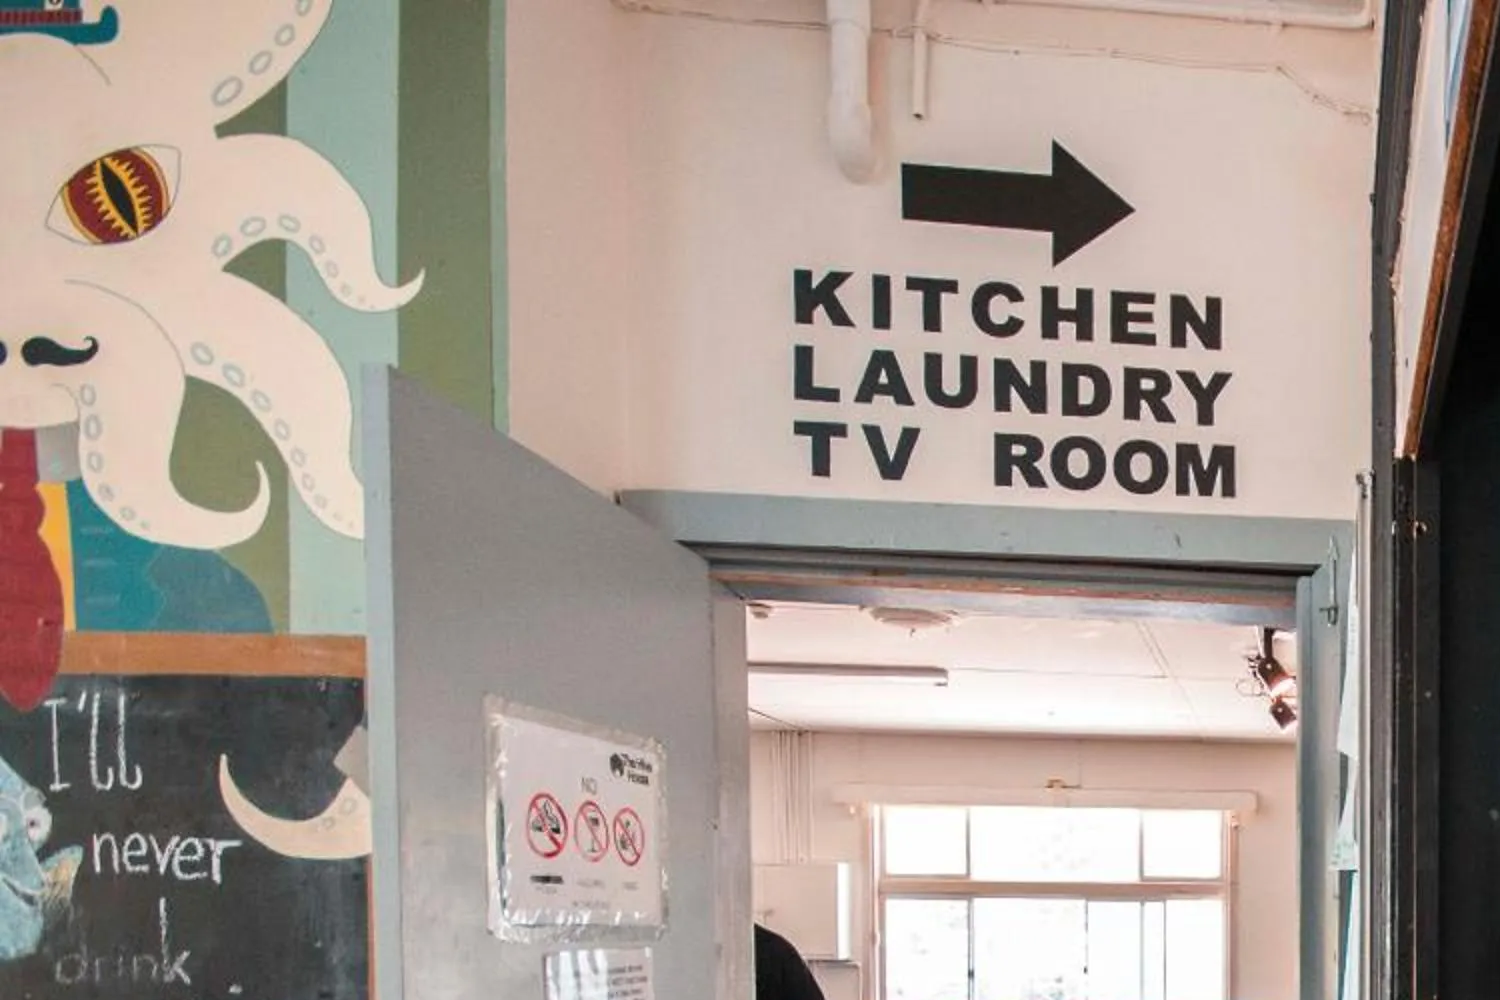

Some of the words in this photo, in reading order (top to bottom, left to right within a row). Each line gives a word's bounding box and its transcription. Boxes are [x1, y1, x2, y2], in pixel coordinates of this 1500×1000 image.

[793, 268, 1223, 351] KITCHEN
[793, 344, 1233, 427] LAUNDRY
[793, 420, 921, 481] TV
[994, 432, 1237, 499] ROOM
[44, 690, 143, 792] I'll
[92, 828, 243, 884] never
[54, 898, 192, 986] drink
